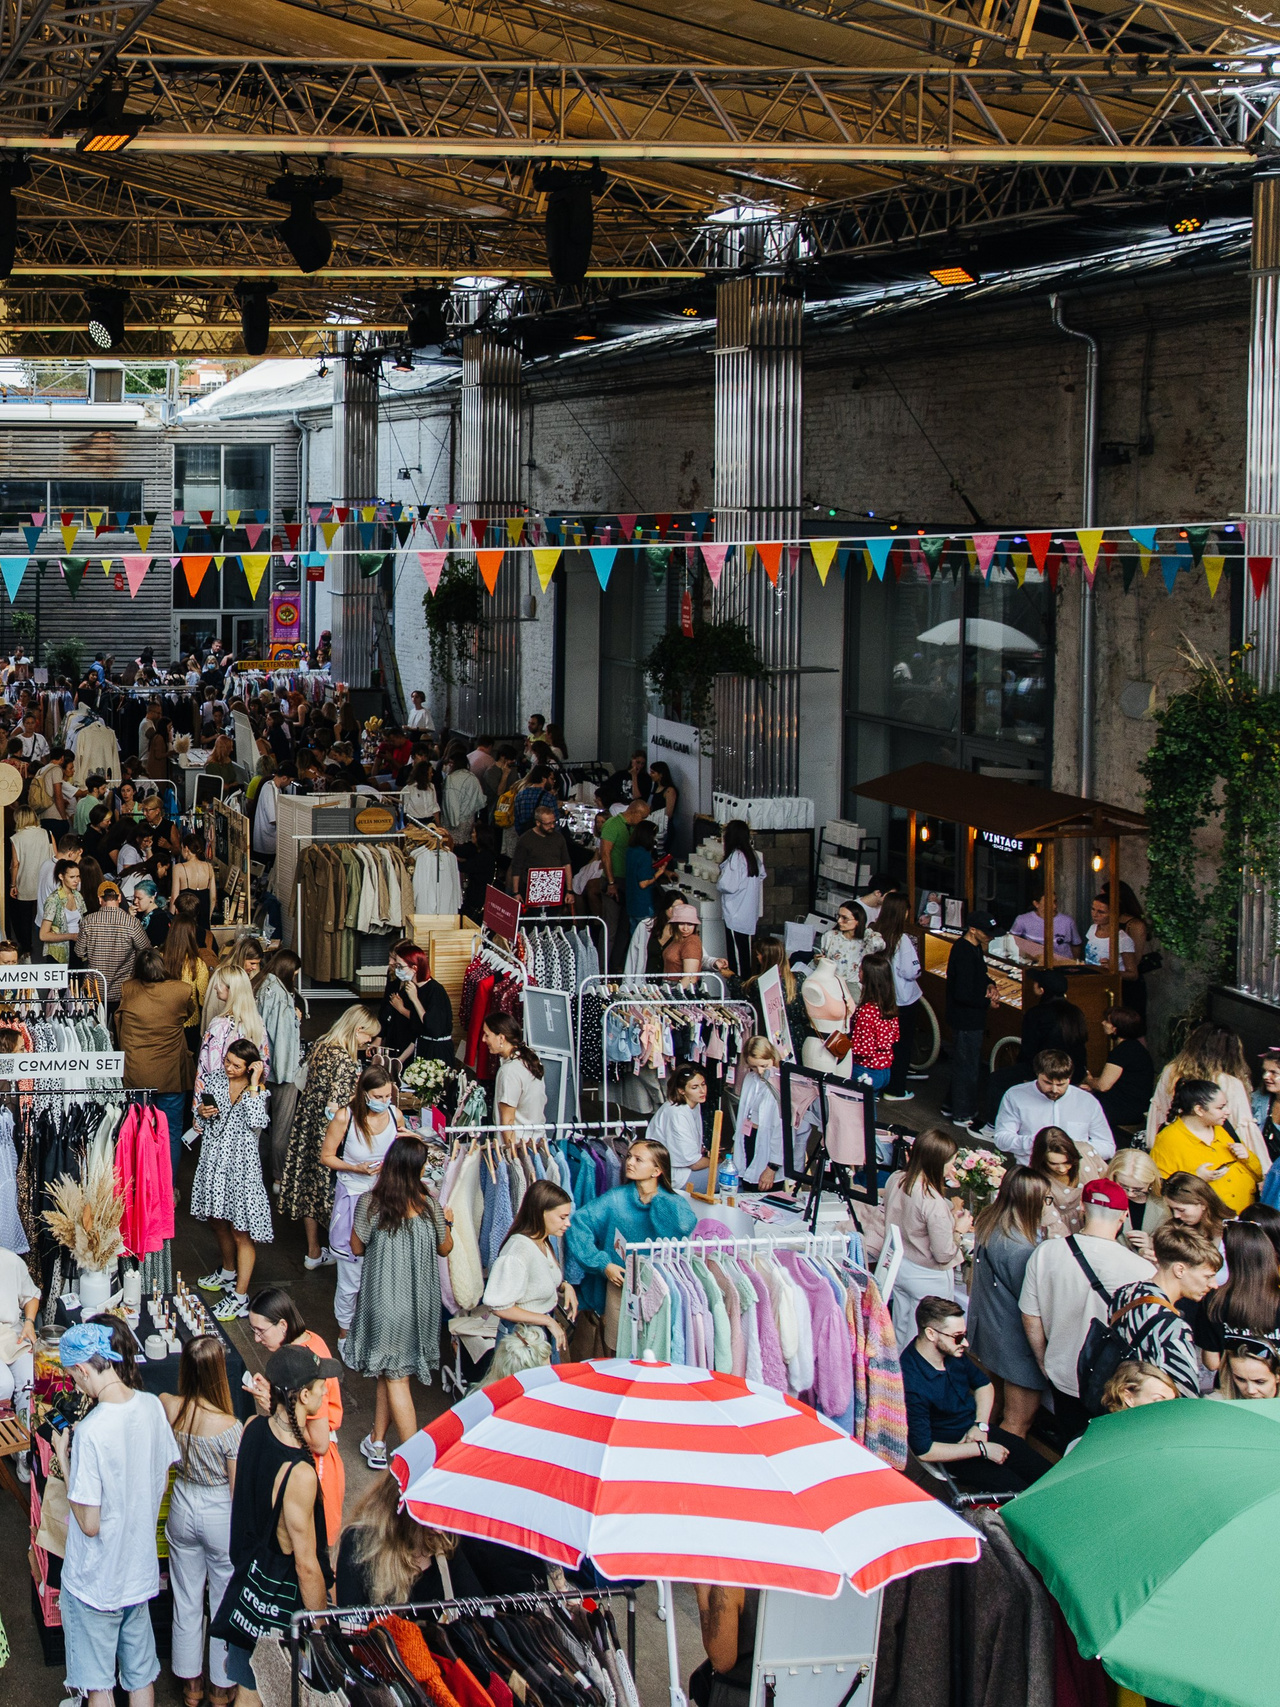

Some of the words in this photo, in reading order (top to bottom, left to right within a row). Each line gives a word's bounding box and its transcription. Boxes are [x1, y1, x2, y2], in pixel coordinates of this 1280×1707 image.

[651, 735, 672, 750] ALOHA
[982, 831, 1023, 850] VINTAGE
[941, 927, 964, 936] G-SHOCK
[44, 970, 66, 982] SET
[18, 1059, 90, 1072] COMMON
[96, 1058, 122, 1070] SET
[250, 1559, 258, 1574] i
[243, 1587, 280, 1617] create
